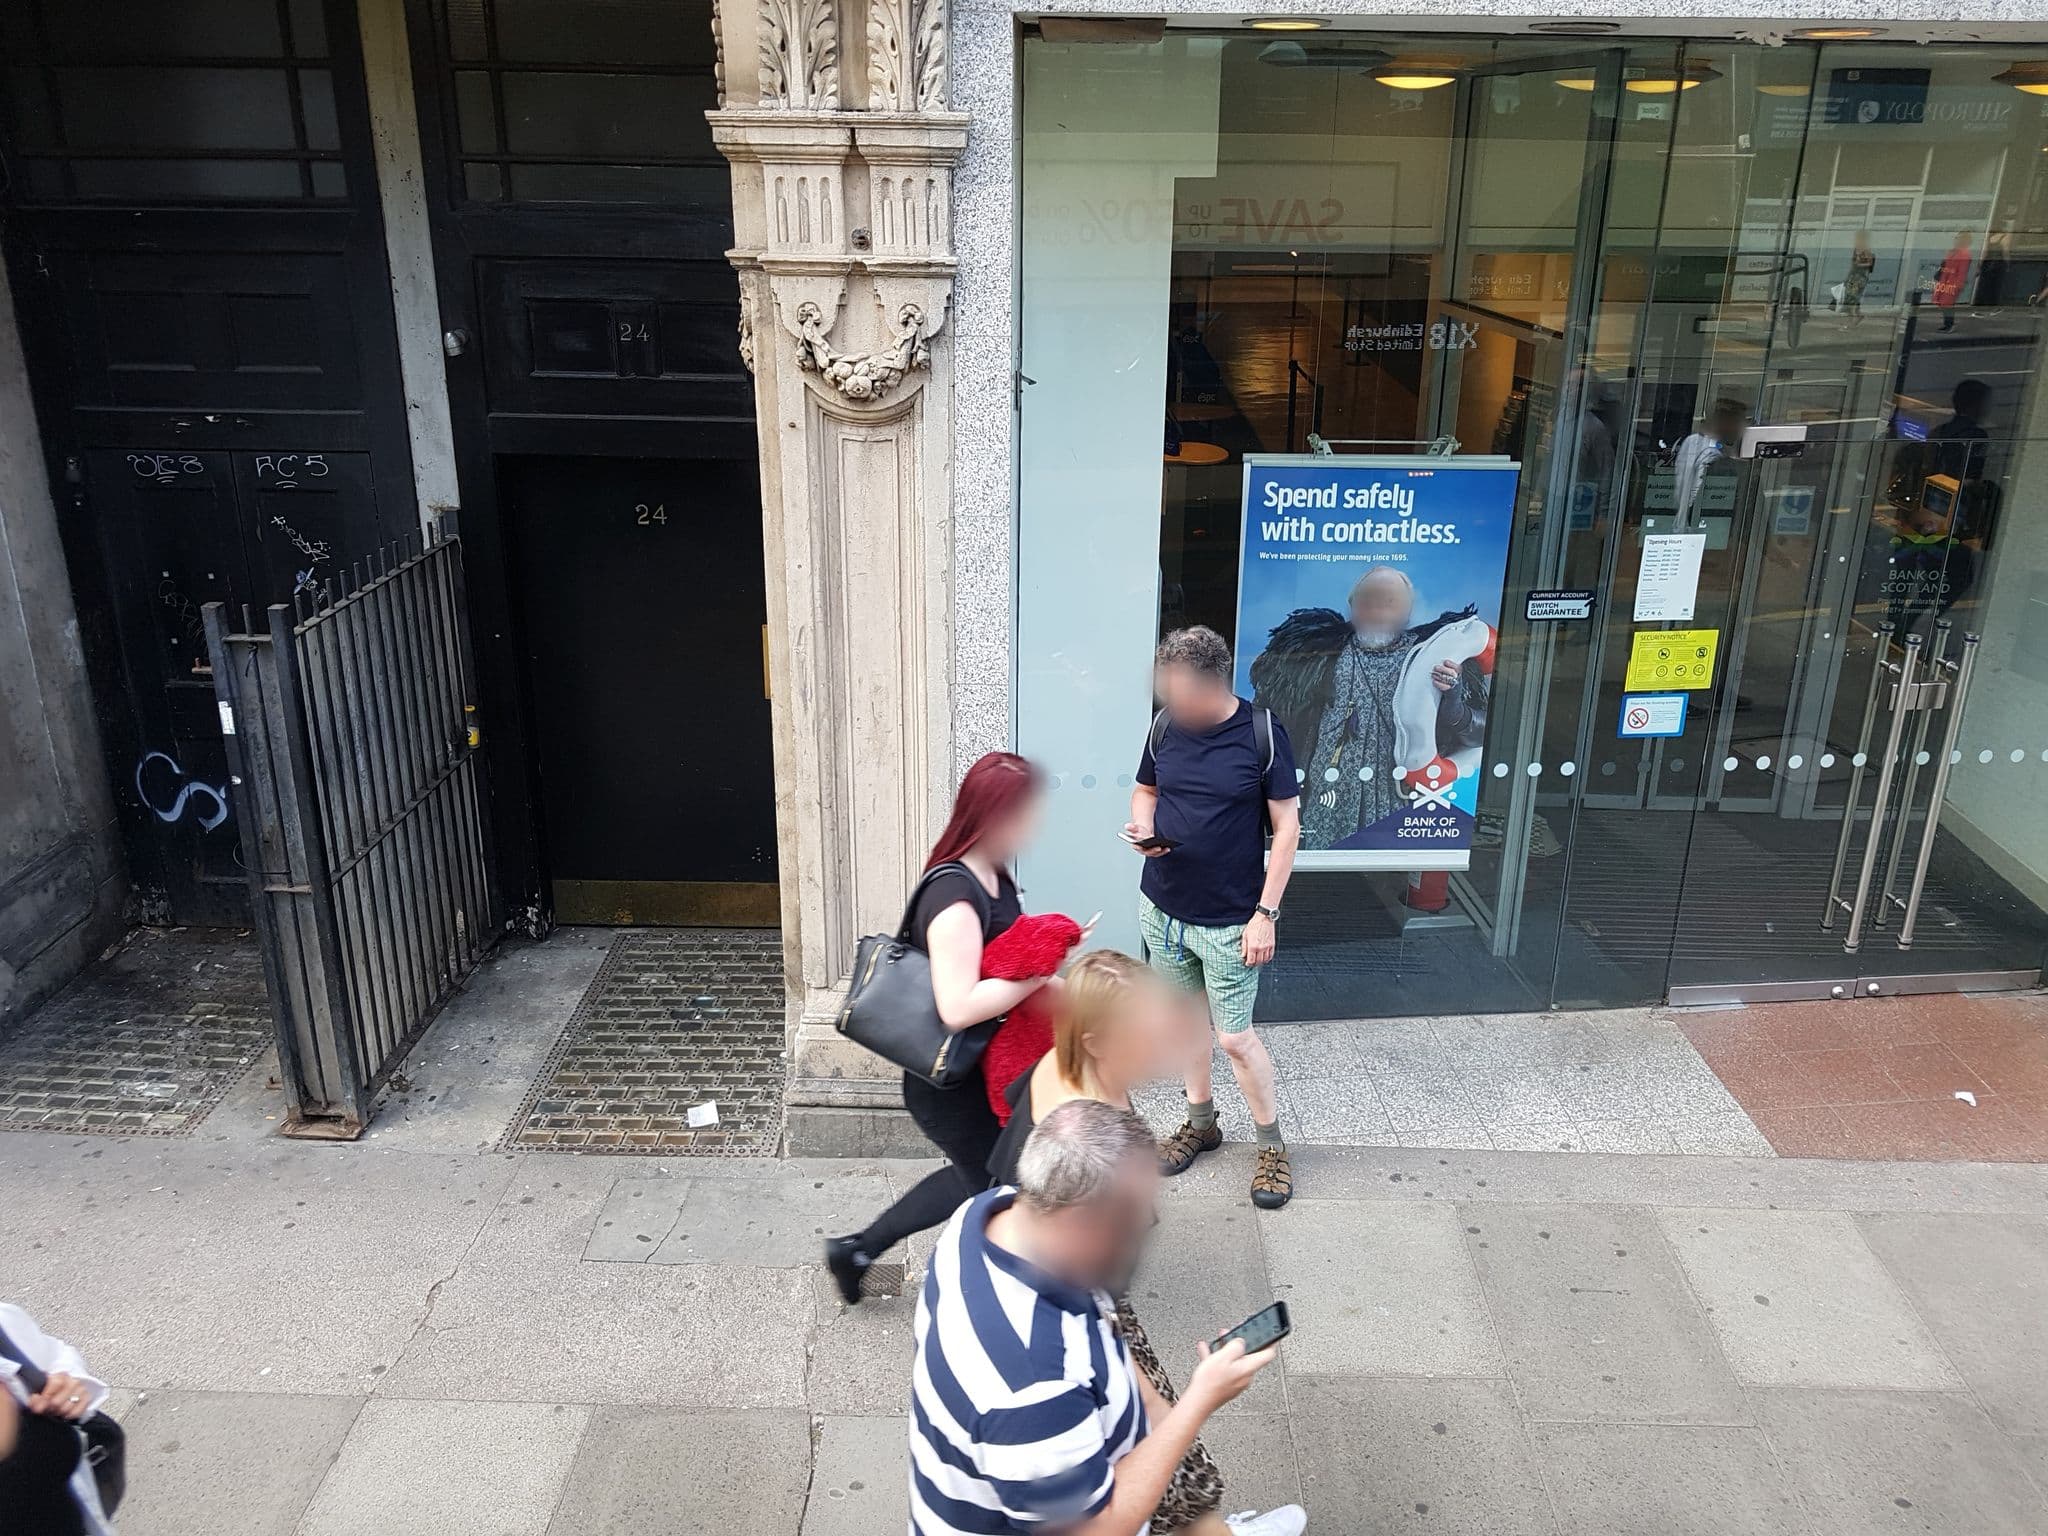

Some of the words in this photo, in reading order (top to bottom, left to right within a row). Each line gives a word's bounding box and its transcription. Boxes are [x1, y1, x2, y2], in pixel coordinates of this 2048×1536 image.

[620, 323, 650, 342] 24
[1263, 481, 1338, 515] Spend
[1342, 482, 1415, 517] safely
[634, 503, 668, 526] 24
[1260, 516, 1315, 542] with
[1321, 518, 1461, 544] contactless.
[1259, 551, 1279, 560] We've
[1279, 552, 1296, 560] been
[1297, 553, 1332, 563] protecting
[1332, 554, 1347, 562] your
[1348, 554, 1371, 562] money
[1372, 553, 1390, 561] since
[1888, 569, 1926, 581] BANK
[1880, 582, 1951, 594] SCOTLAND
[1530, 608, 1583, 616] GUARANTEE
[1404, 816, 1437, 827] BANK
[1439, 817, 1457, 827] OF
[1397, 828, 1460, 838] SCOTLAND
